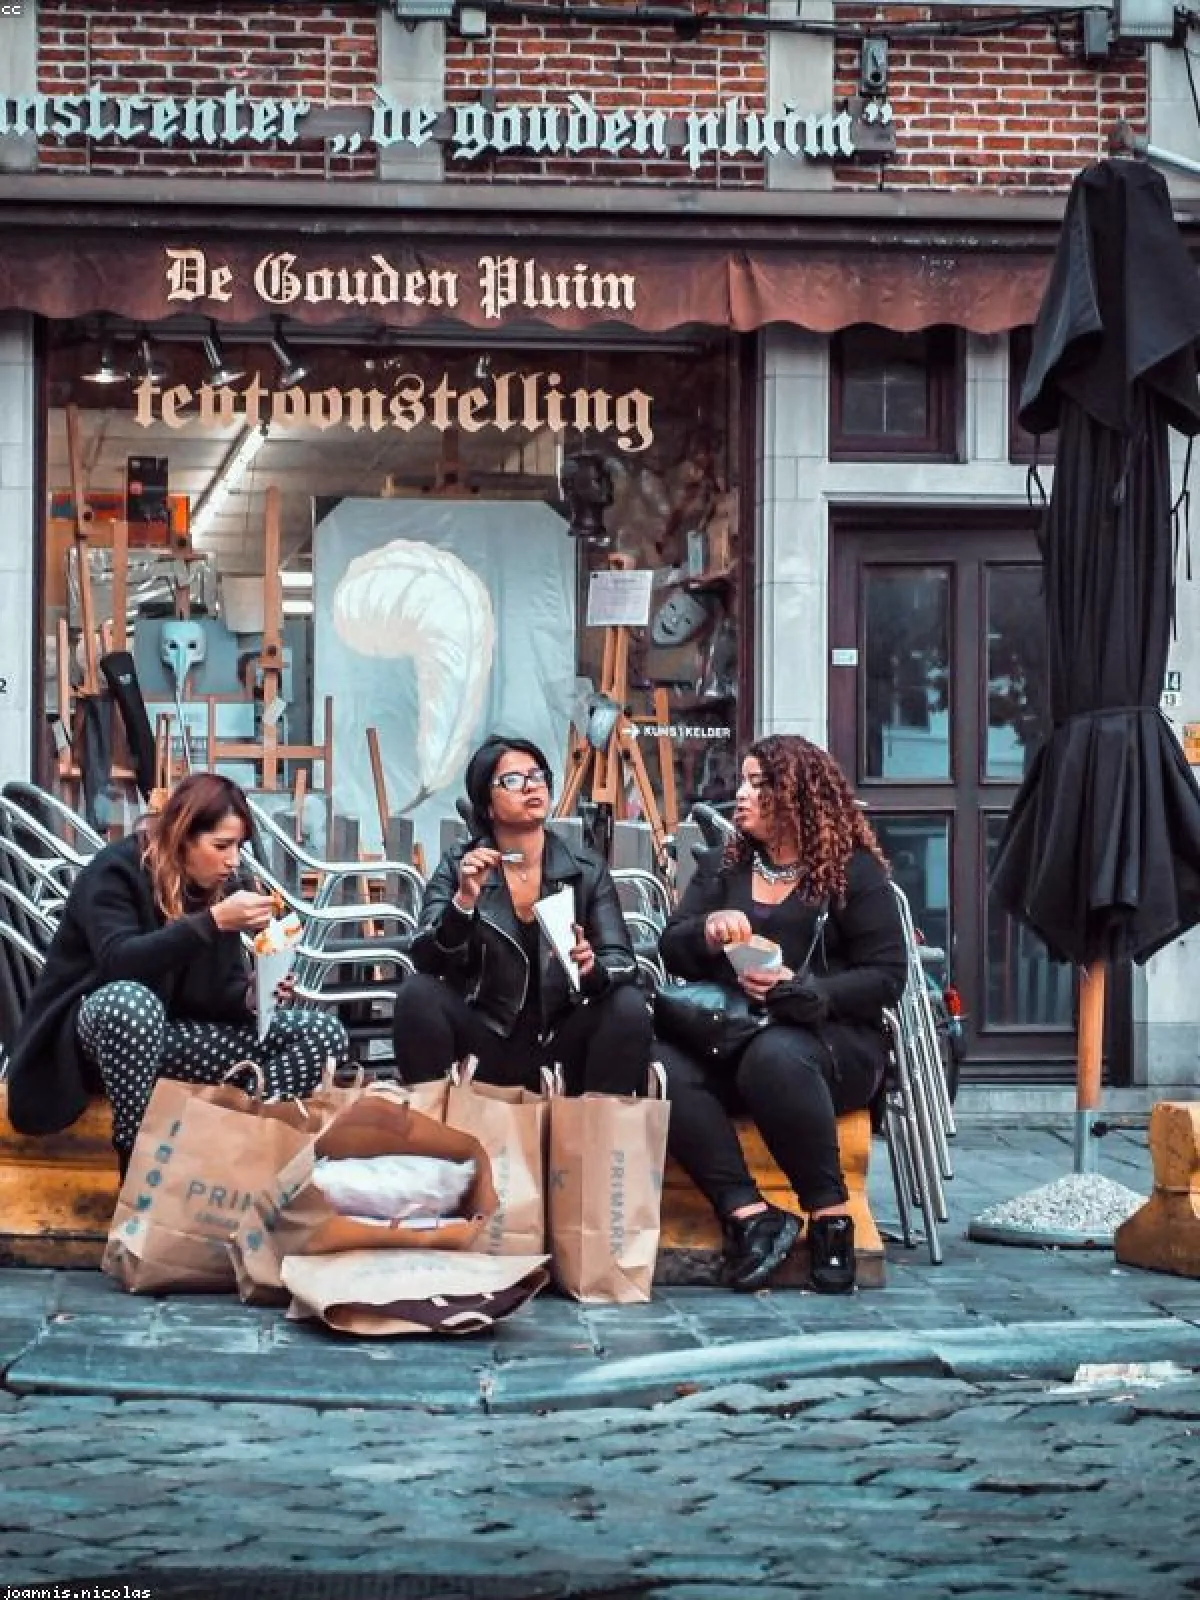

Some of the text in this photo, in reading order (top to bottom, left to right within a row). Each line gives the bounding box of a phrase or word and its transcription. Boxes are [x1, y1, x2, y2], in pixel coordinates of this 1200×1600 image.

[452, 93, 668, 160] gouden
[164, 248, 637, 319] De Gouden Pluim
[133, 370, 655, 452] tentoonstelling
